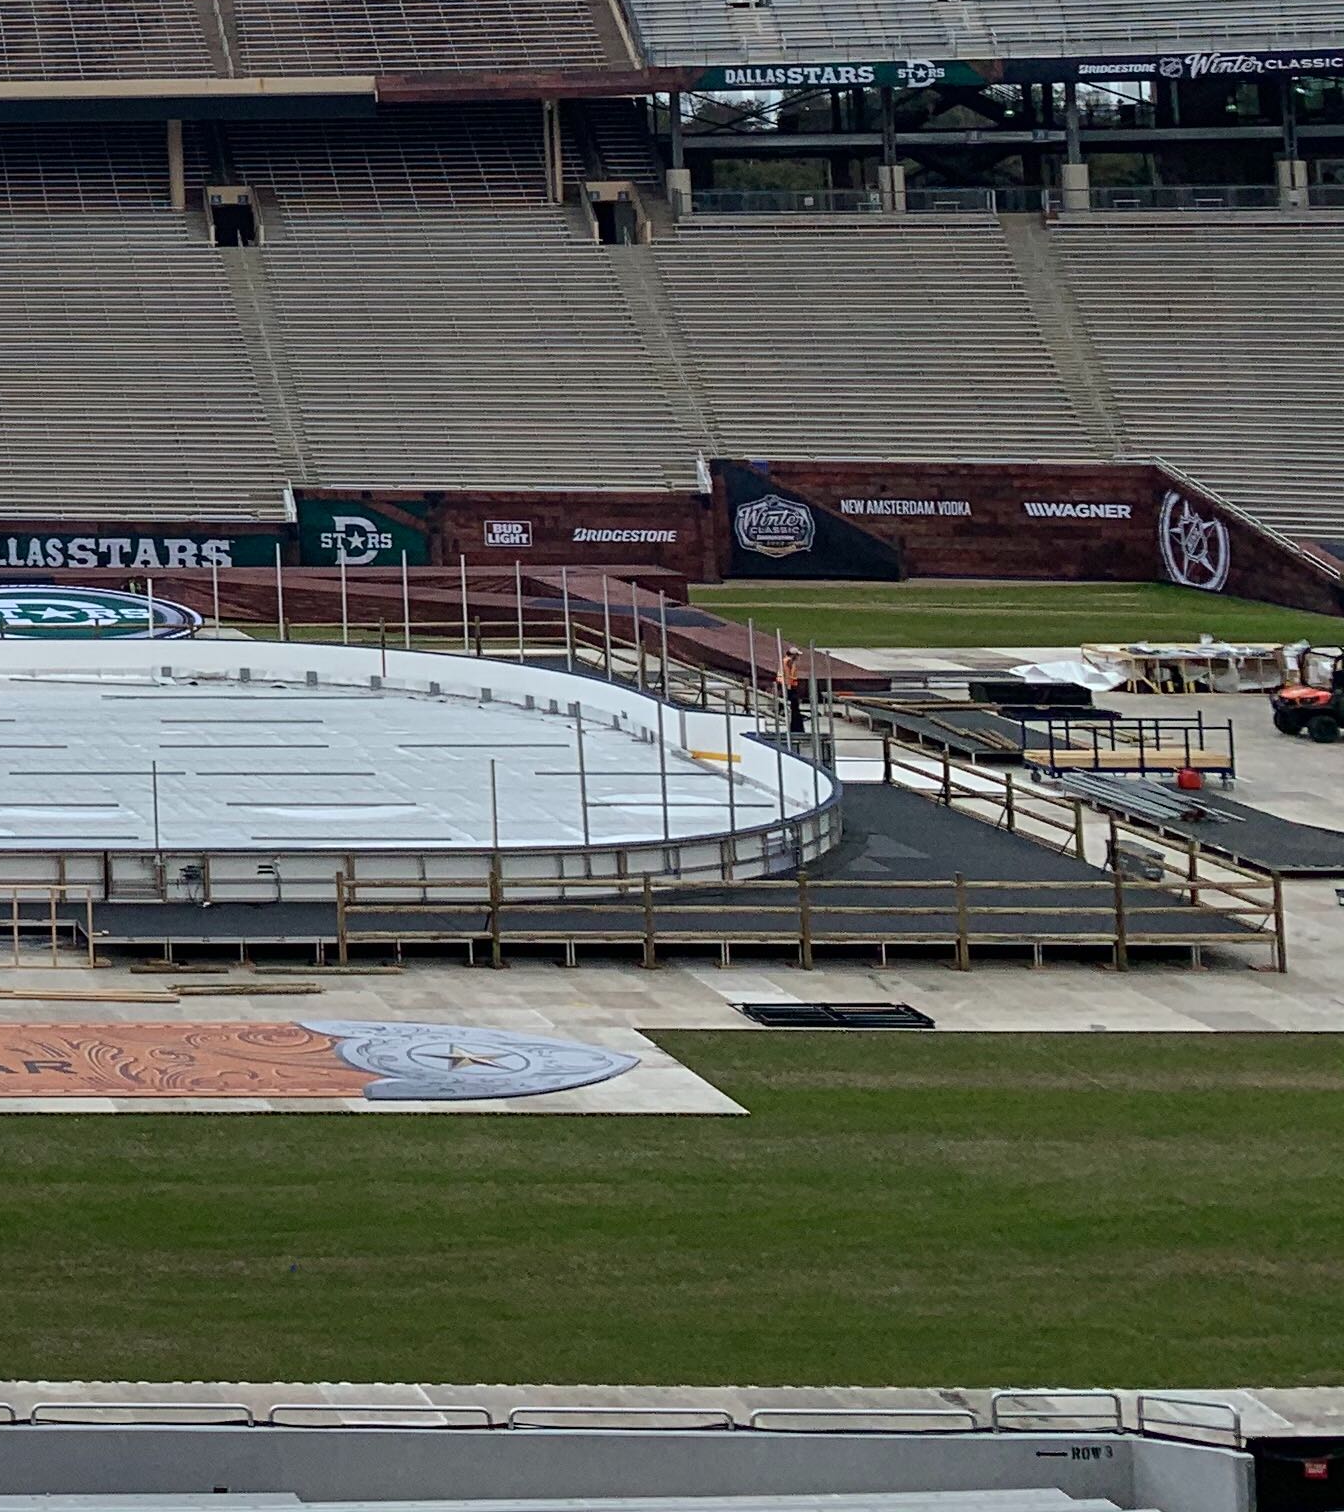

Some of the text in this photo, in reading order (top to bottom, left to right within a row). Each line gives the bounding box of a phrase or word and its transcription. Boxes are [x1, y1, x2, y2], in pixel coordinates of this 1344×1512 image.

[1078, 62, 1157, 74] BRIDGESTONE
[1184, 53, 1266, 79] Winter
[1265, 57, 1344, 70] CLASSIC
[724, 66, 875, 85] DALLAS STARS
[840, 499, 972, 517] NEW AMSTERDAM VODKA
[1047, 502, 1132, 519] WAGNER
[739, 505, 808, 529] Winter
[492, 523, 522, 534] BUD
[572, 527, 677, 543] BRIDGESTONE
[750, 526, 801, 535] CLASSIC
[487, 534, 529, 545] LIGHT
[66, 538, 233, 569] STARS
[1072, 1446, 1101, 1460] ROW
